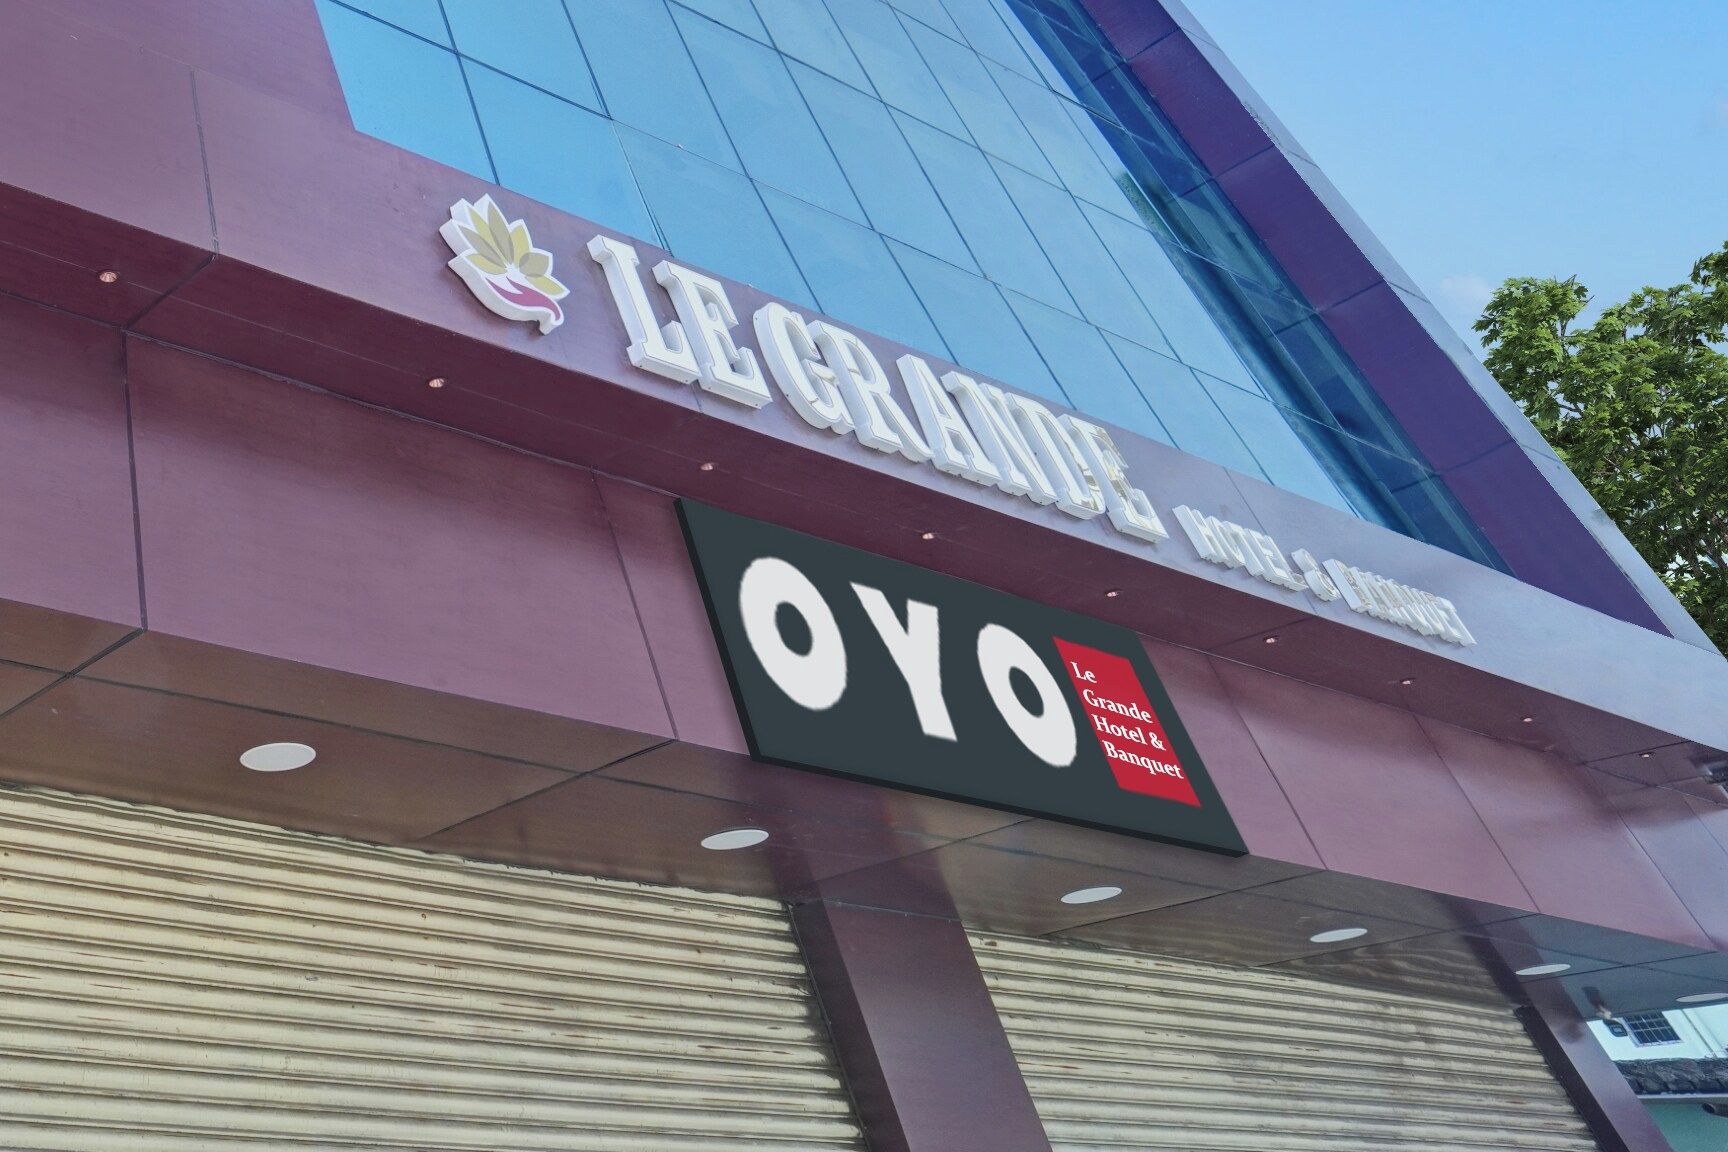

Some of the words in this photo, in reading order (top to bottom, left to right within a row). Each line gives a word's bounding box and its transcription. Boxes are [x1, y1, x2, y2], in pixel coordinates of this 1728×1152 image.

[587, 234, 773, 410] LE
[753, 301, 1170, 544] GRANDE
[1171, 504, 1310, 592] HOTEL
[739, 556, 1078, 768] OYO
[1070, 661, 1098, 684] Le
[1082, 688, 1154, 724] Grande
[1091, 713, 1148, 746] Hotel
[1148, 731, 1167, 751] &
[1101, 739, 1185, 779] Banquet
